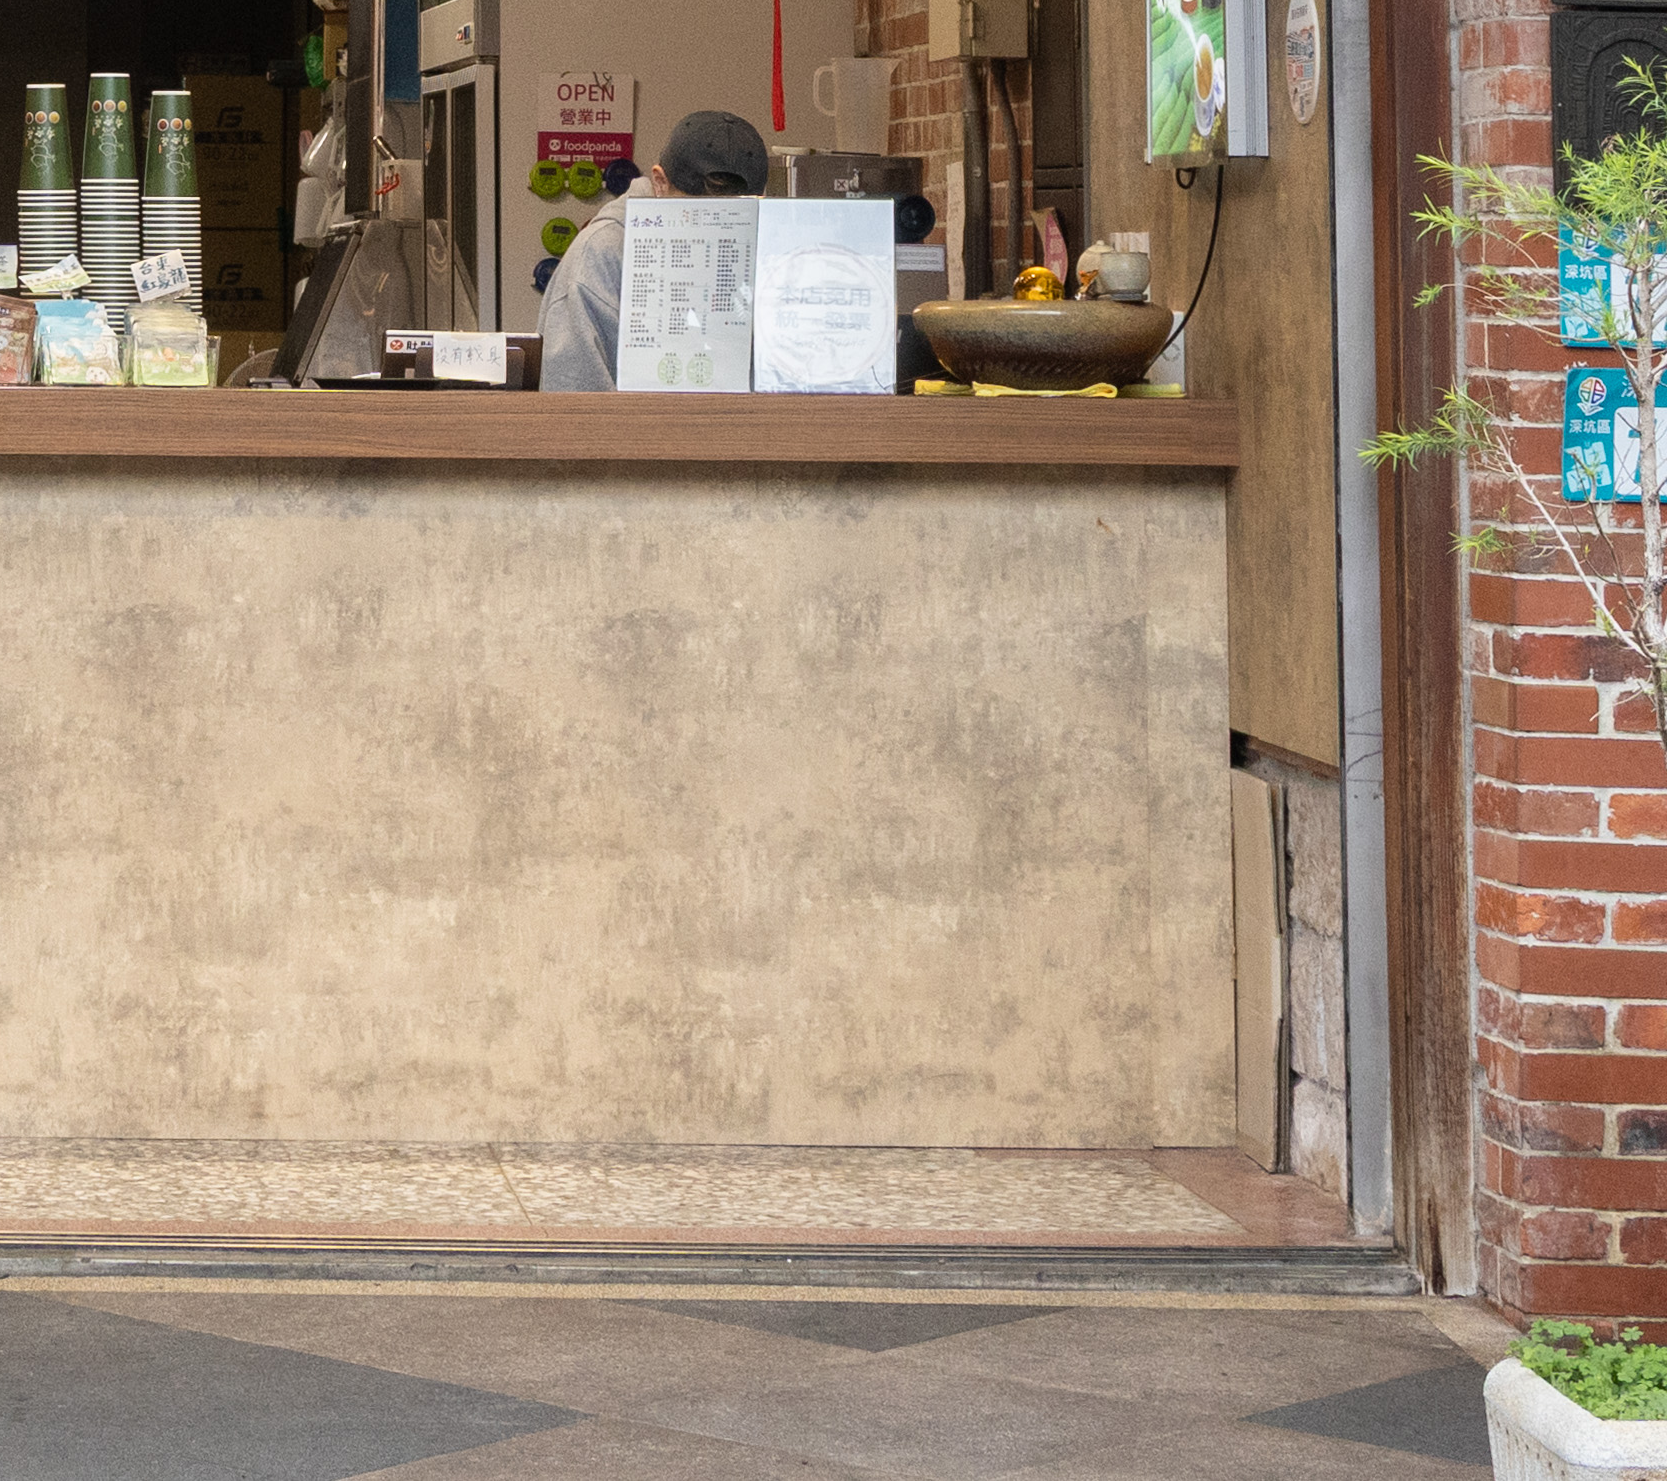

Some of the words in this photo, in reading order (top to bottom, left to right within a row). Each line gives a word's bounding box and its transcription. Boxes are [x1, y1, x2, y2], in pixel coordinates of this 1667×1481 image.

[557, 83, 615, 102] OPEN
[560, 108, 612, 126] 營業中
[564, 140, 622, 153] foodpanda
[138, 256, 171, 276] 台東
[1564, 264, 1608, 280] 深坑區
[139, 266, 188, 294] 紅烏龍
[1568, 419, 1612, 435] 深坑區
